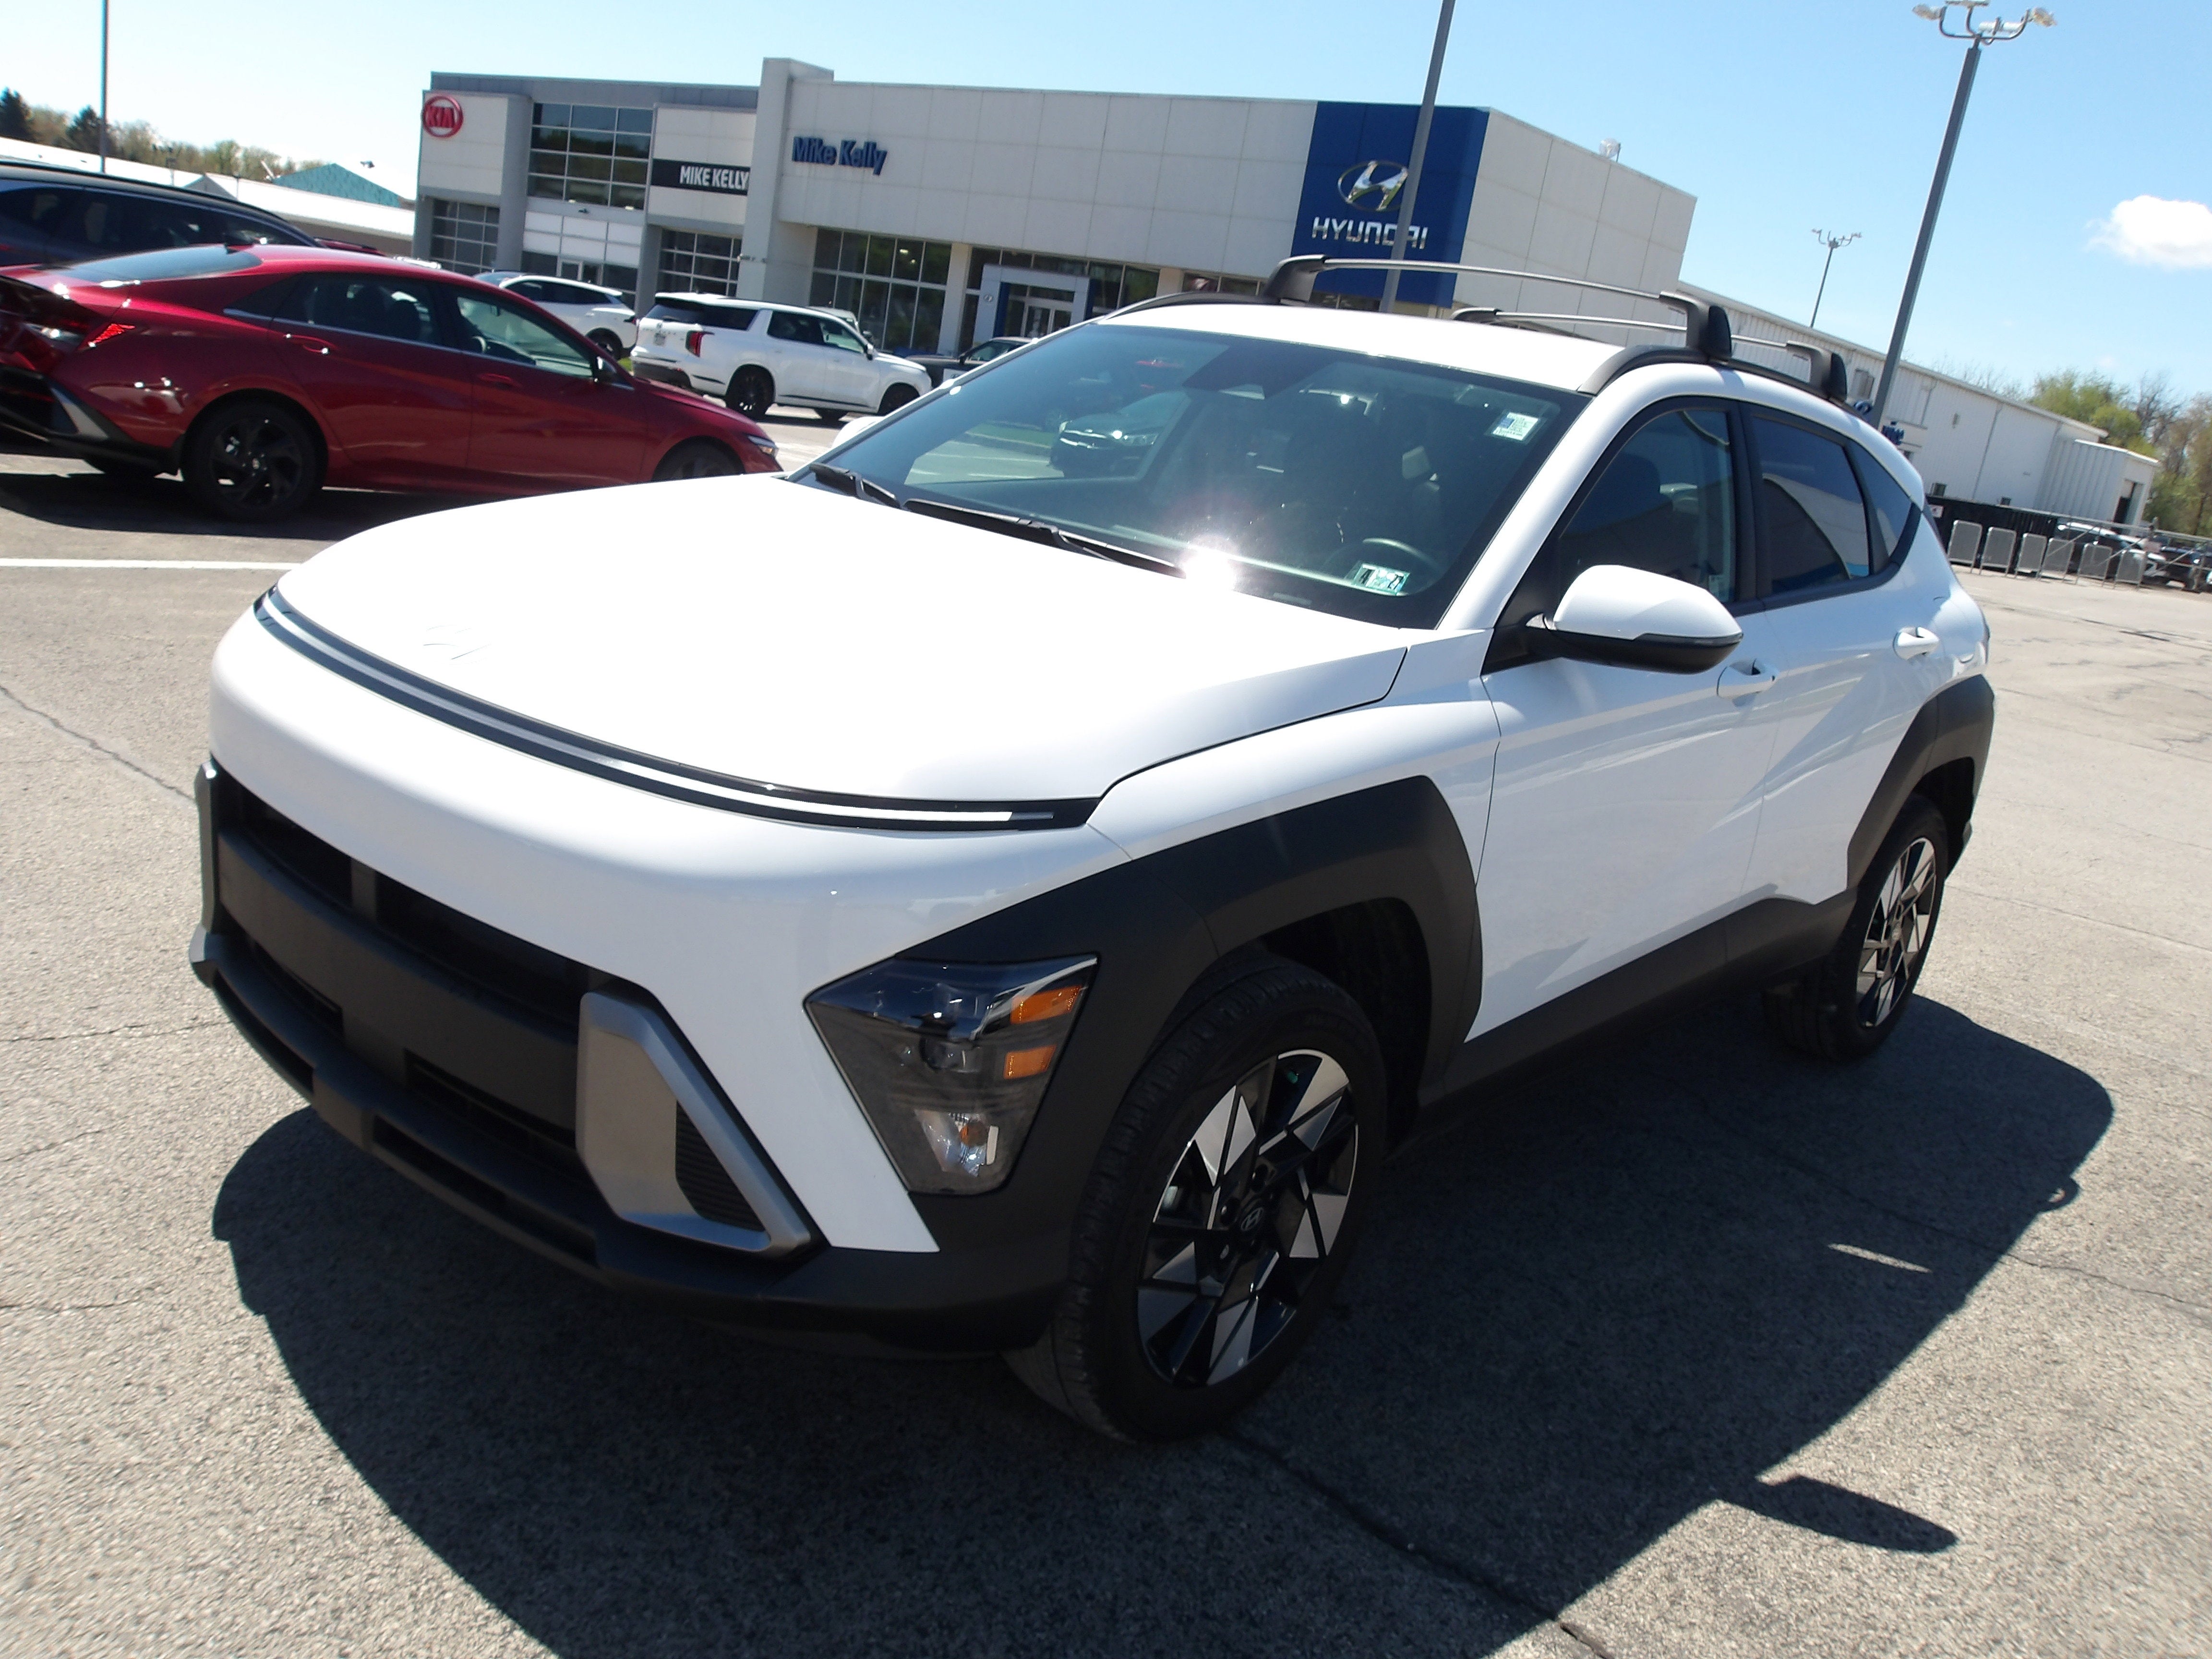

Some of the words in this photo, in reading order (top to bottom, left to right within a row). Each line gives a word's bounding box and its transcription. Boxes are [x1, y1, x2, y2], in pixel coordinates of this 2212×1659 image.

[426, 106, 455, 128] KIA
[792, 136, 837, 165] Mike
[839, 140, 887, 176] Kelly
[679, 165, 711, 186] MIKE
[712, 168, 749, 190] KELLY
